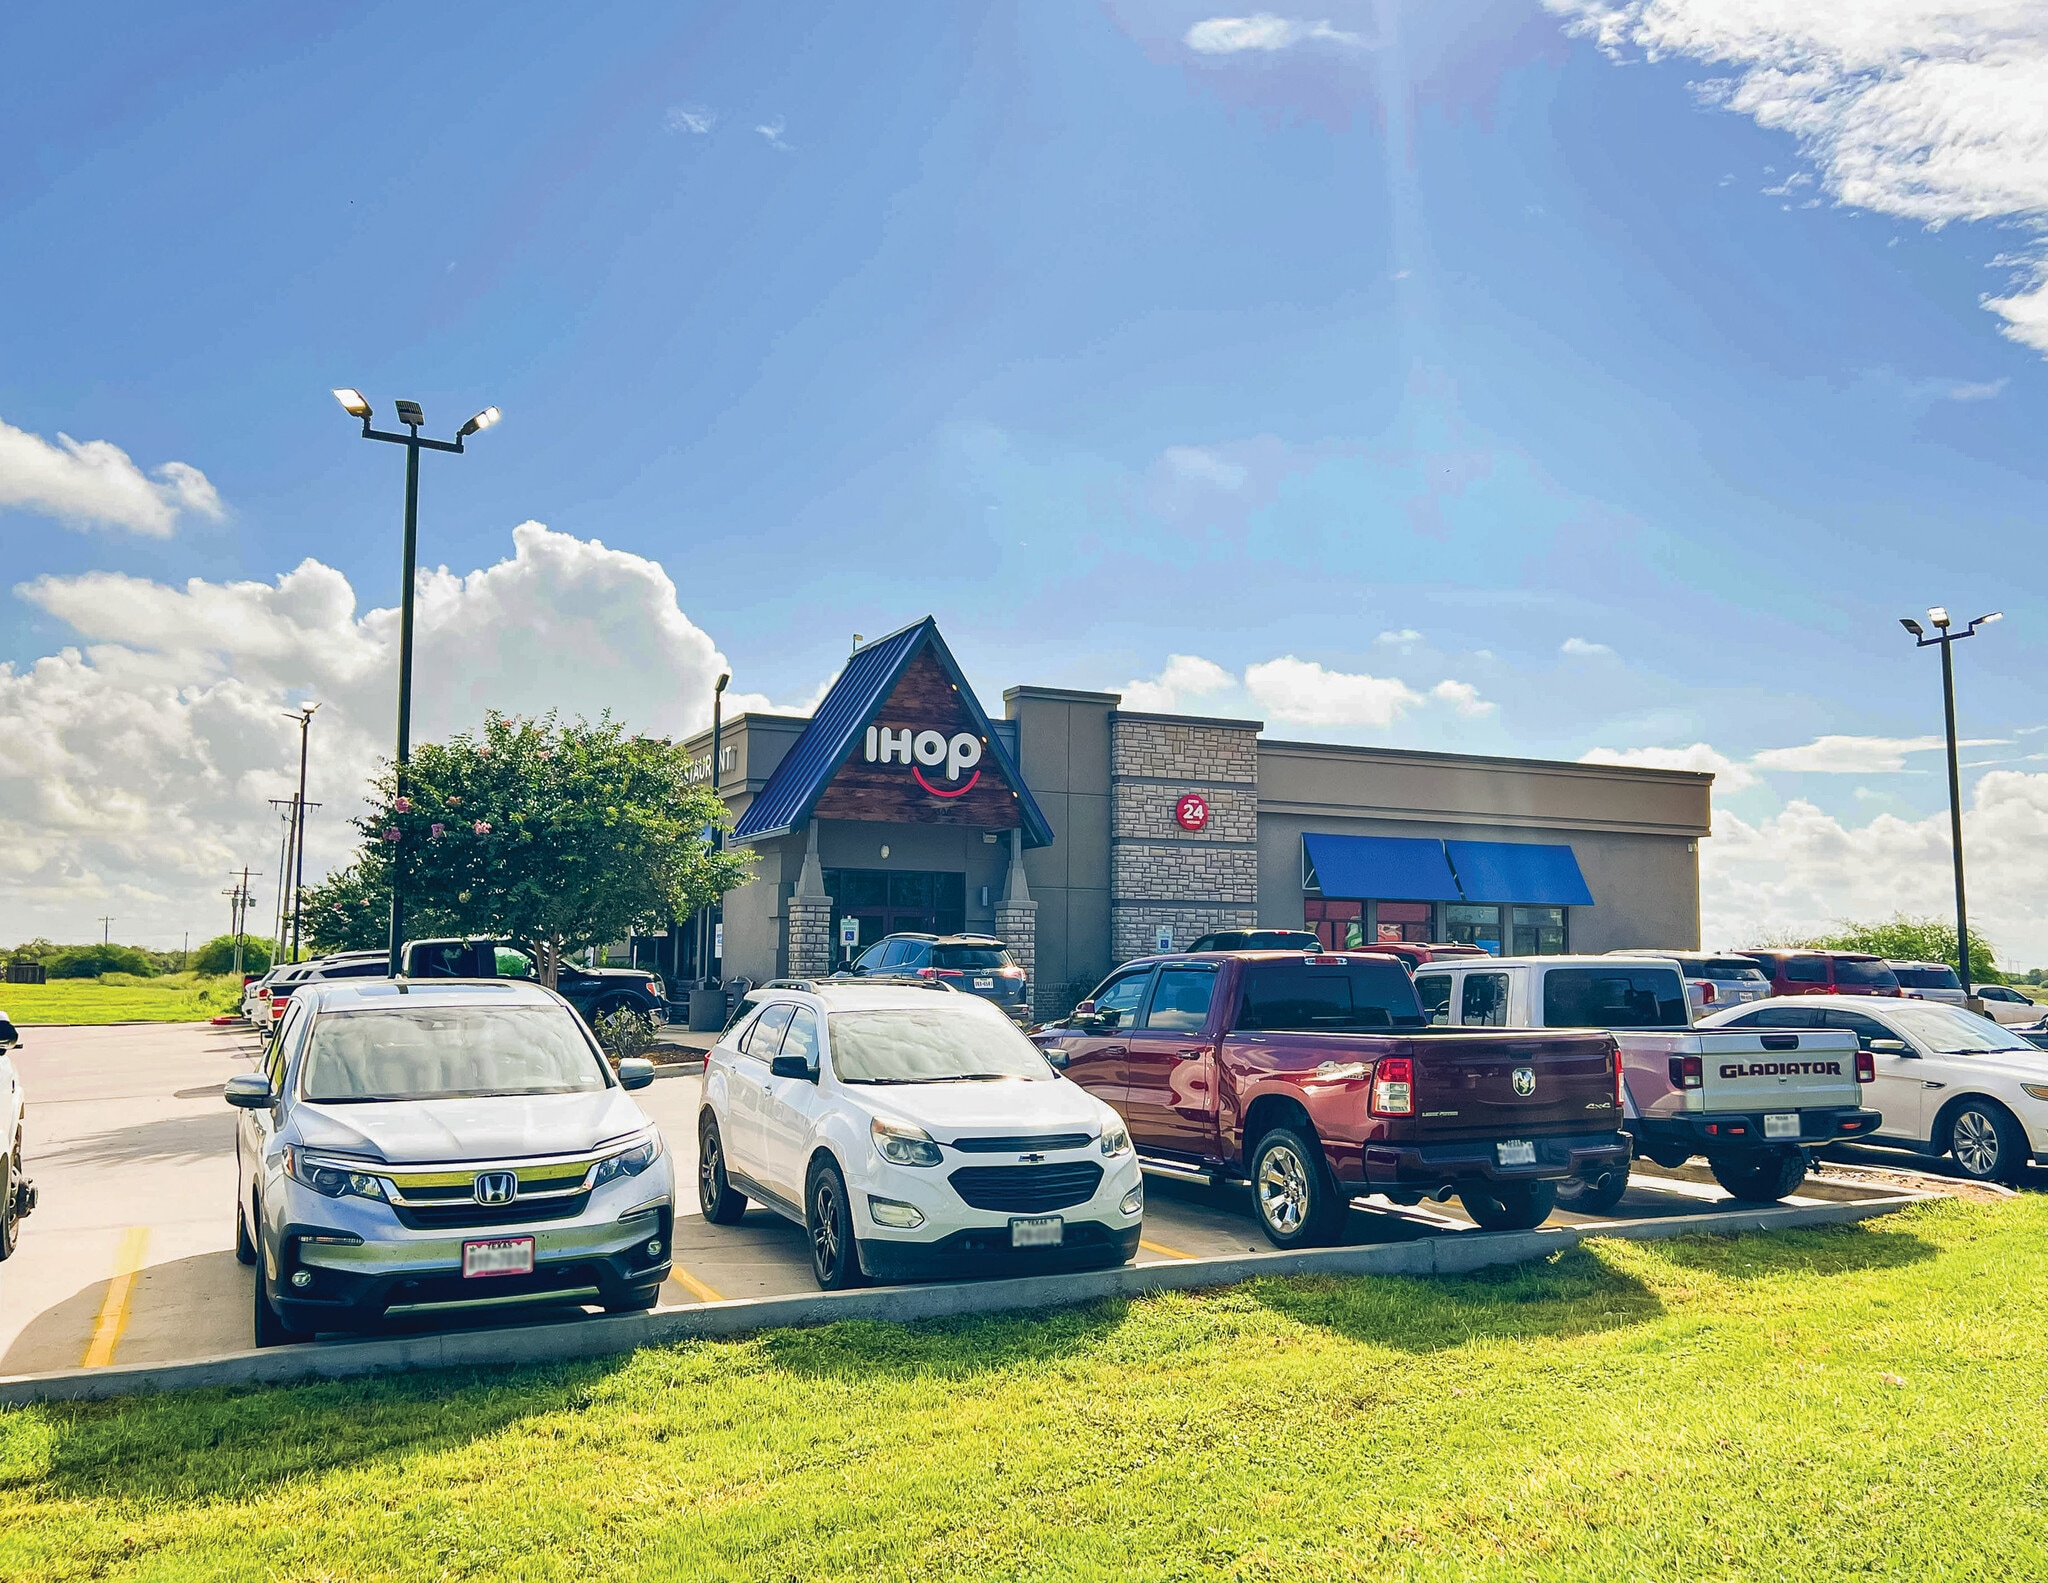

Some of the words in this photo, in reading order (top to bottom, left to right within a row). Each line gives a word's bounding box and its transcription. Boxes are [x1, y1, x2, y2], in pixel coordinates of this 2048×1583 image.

[1183, 803, 1205, 820] 24
[1719, 1061, 1842, 1079] GLADIATOR
[487, 1241, 513, 1250] TEXAS
